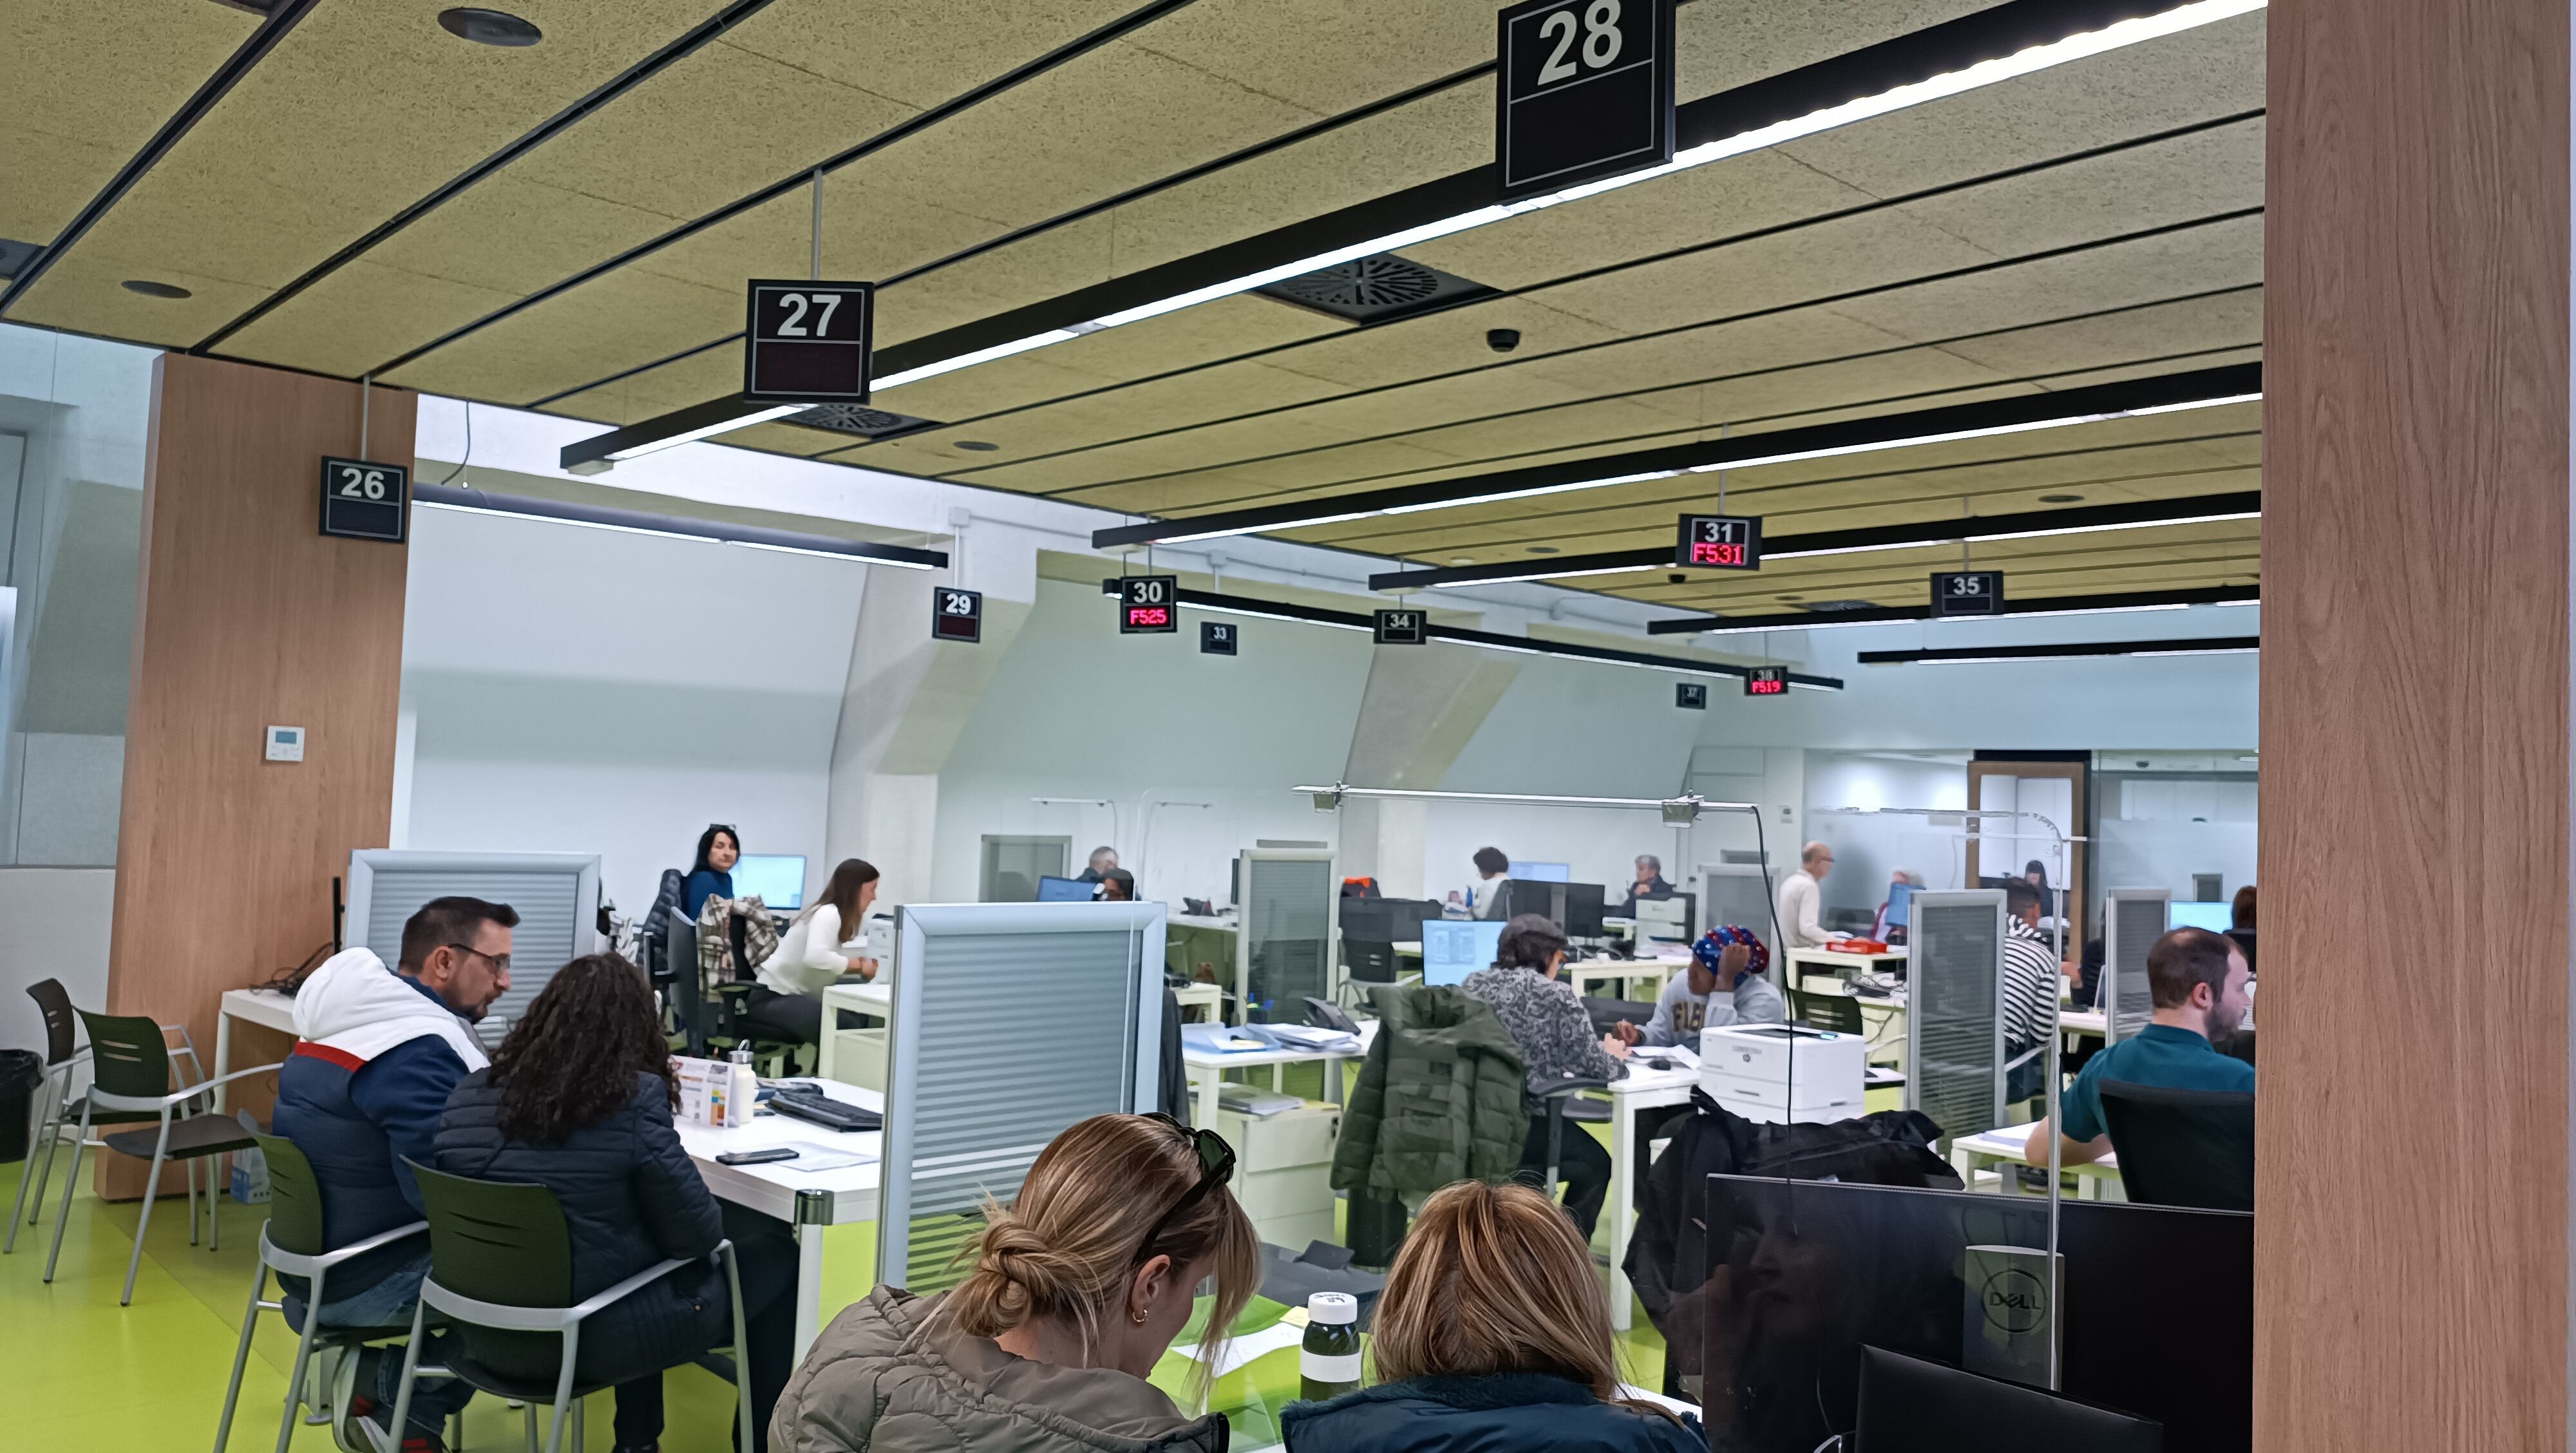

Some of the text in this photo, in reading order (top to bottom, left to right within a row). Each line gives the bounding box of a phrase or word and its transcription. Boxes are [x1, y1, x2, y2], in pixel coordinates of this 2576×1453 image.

[1537, 0, 1622, 86] 28
[777, 293, 841, 337] 27
[341, 468, 385, 500] 26
[1704, 522, 1732, 542] 31
[1693, 543, 1742, 565] F531
[1133, 582, 1162, 603] 30
[1953, 576, 1980, 596] 35
[945, 593, 971, 615] 29
[1130, 609, 1167, 624] F525
[1390, 613, 1409, 629] 34
[1752, 681, 1781, 693] F519
[1989, 1291, 2042, 1309] DELL
